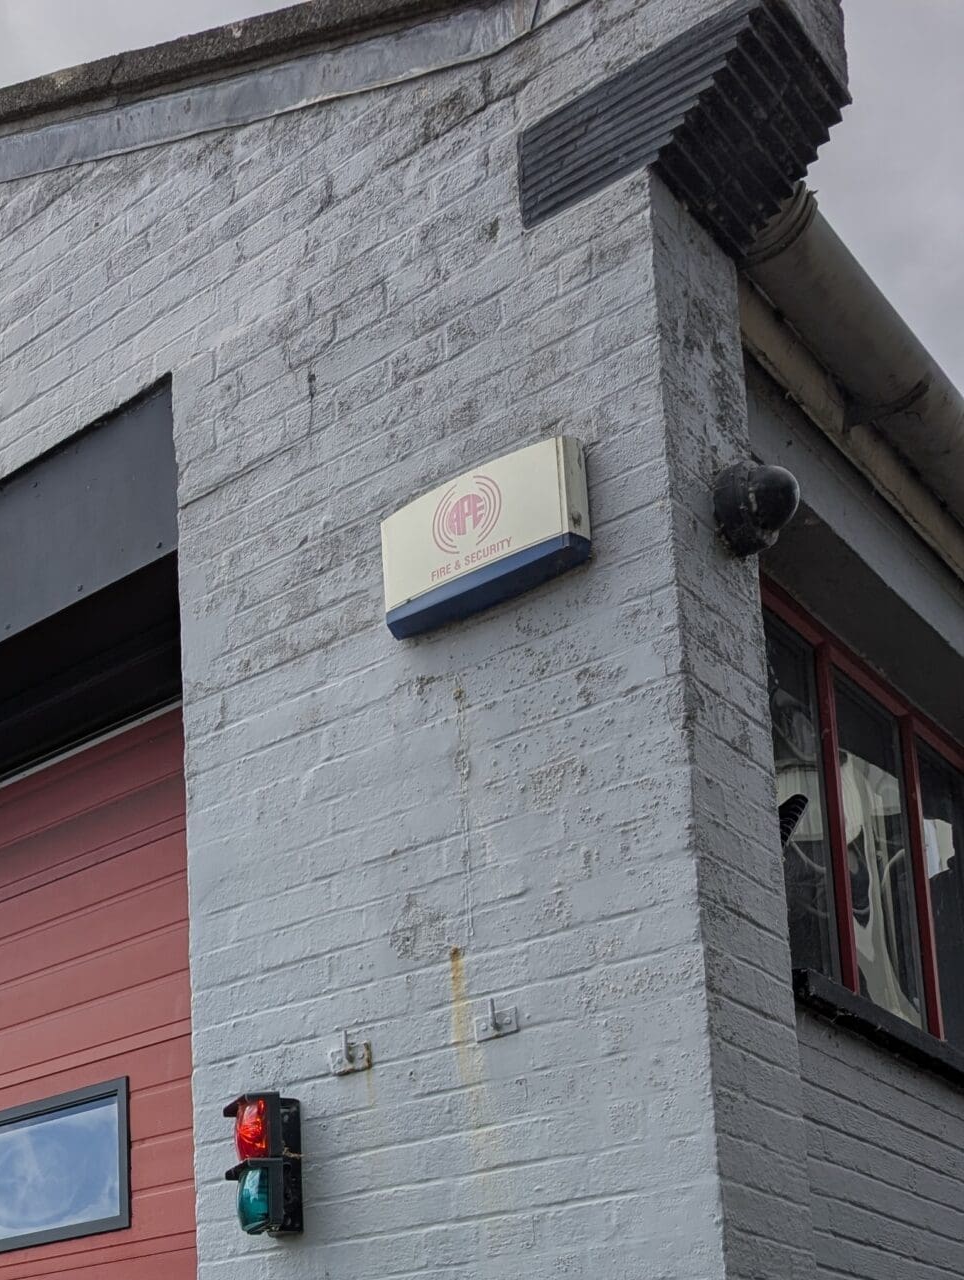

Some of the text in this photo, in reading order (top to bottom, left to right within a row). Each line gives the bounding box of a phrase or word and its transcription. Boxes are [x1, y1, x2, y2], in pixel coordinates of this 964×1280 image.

[431, 536, 512, 582] FIRE & SECURITY
